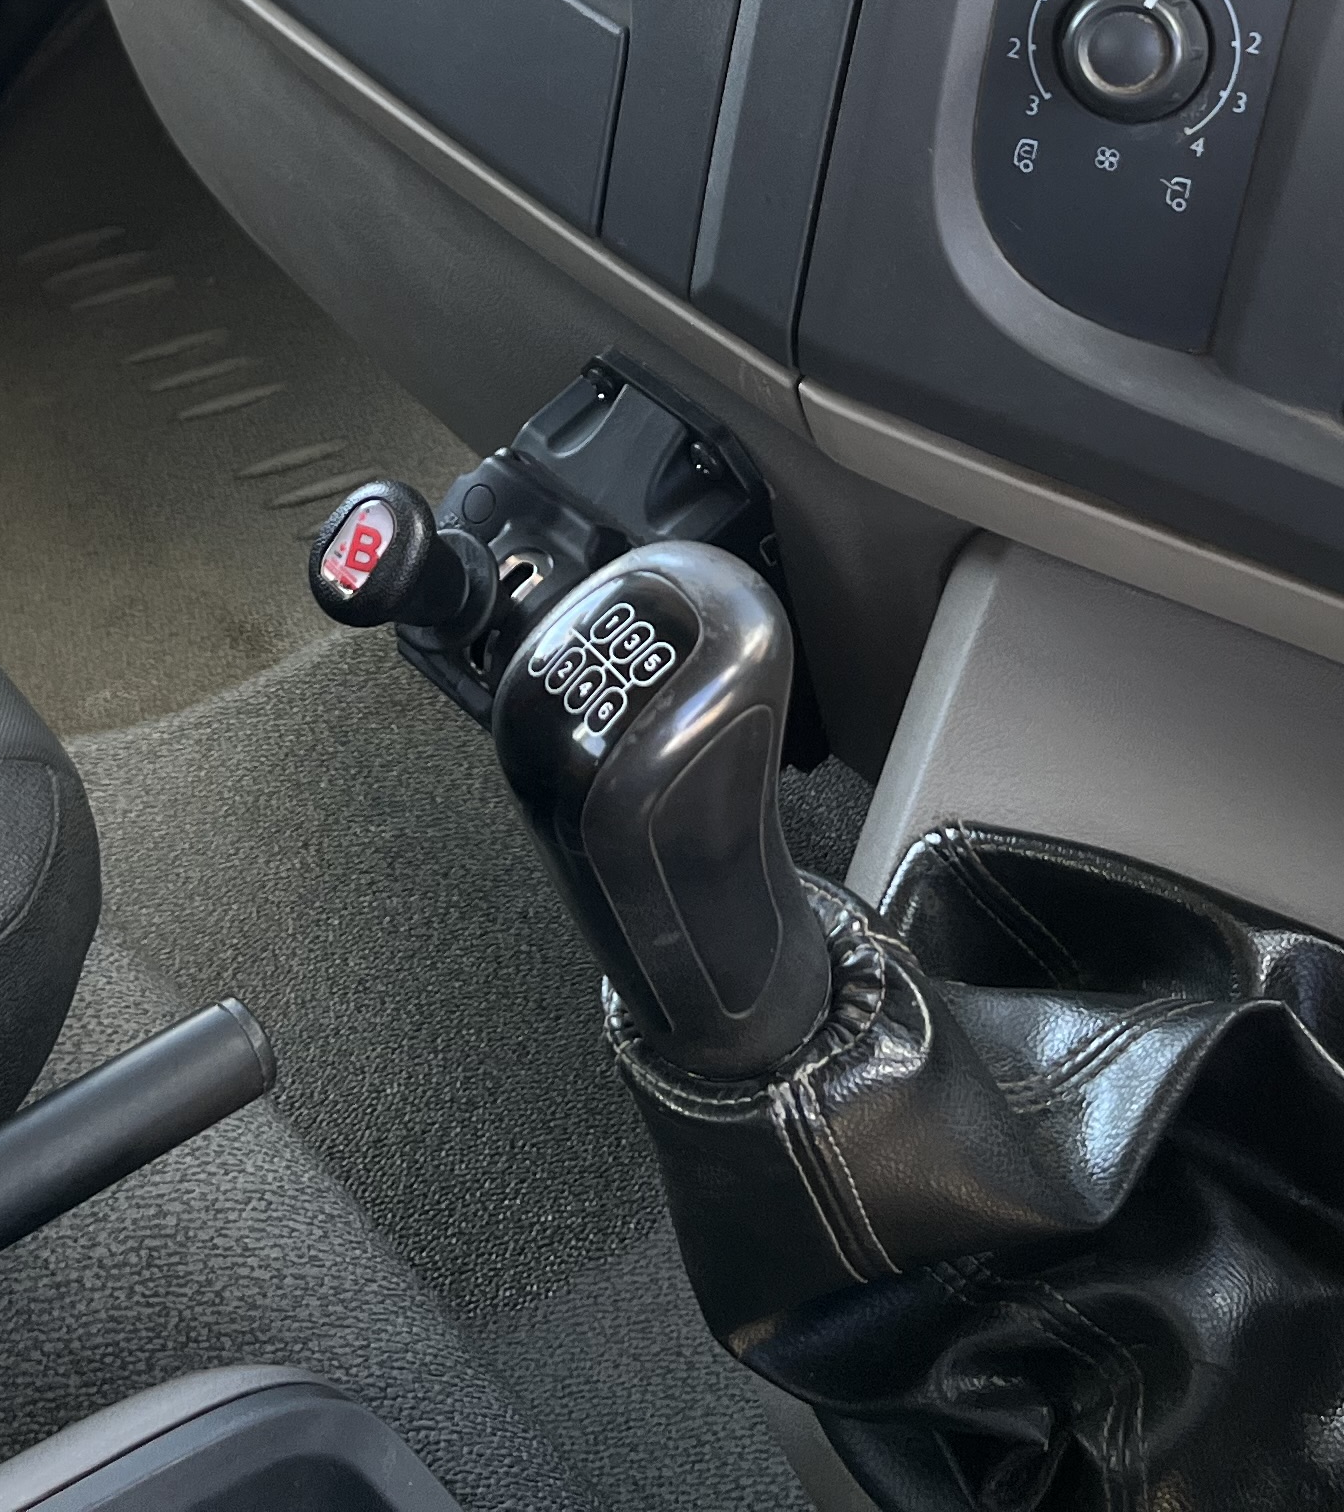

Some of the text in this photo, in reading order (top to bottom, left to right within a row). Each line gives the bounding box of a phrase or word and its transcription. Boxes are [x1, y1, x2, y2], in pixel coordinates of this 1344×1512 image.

[1006, 37, 1021, 60] 2
[1245, 31, 1263, 55] 2
[1025, 95, 1040, 116] 3
[1232, 92, 1248, 113] 3
[1190, 137, 1205, 157] 4
[605, 615, 662, 672] 1 3 5
[557, 660, 614, 720] 2 4 6
